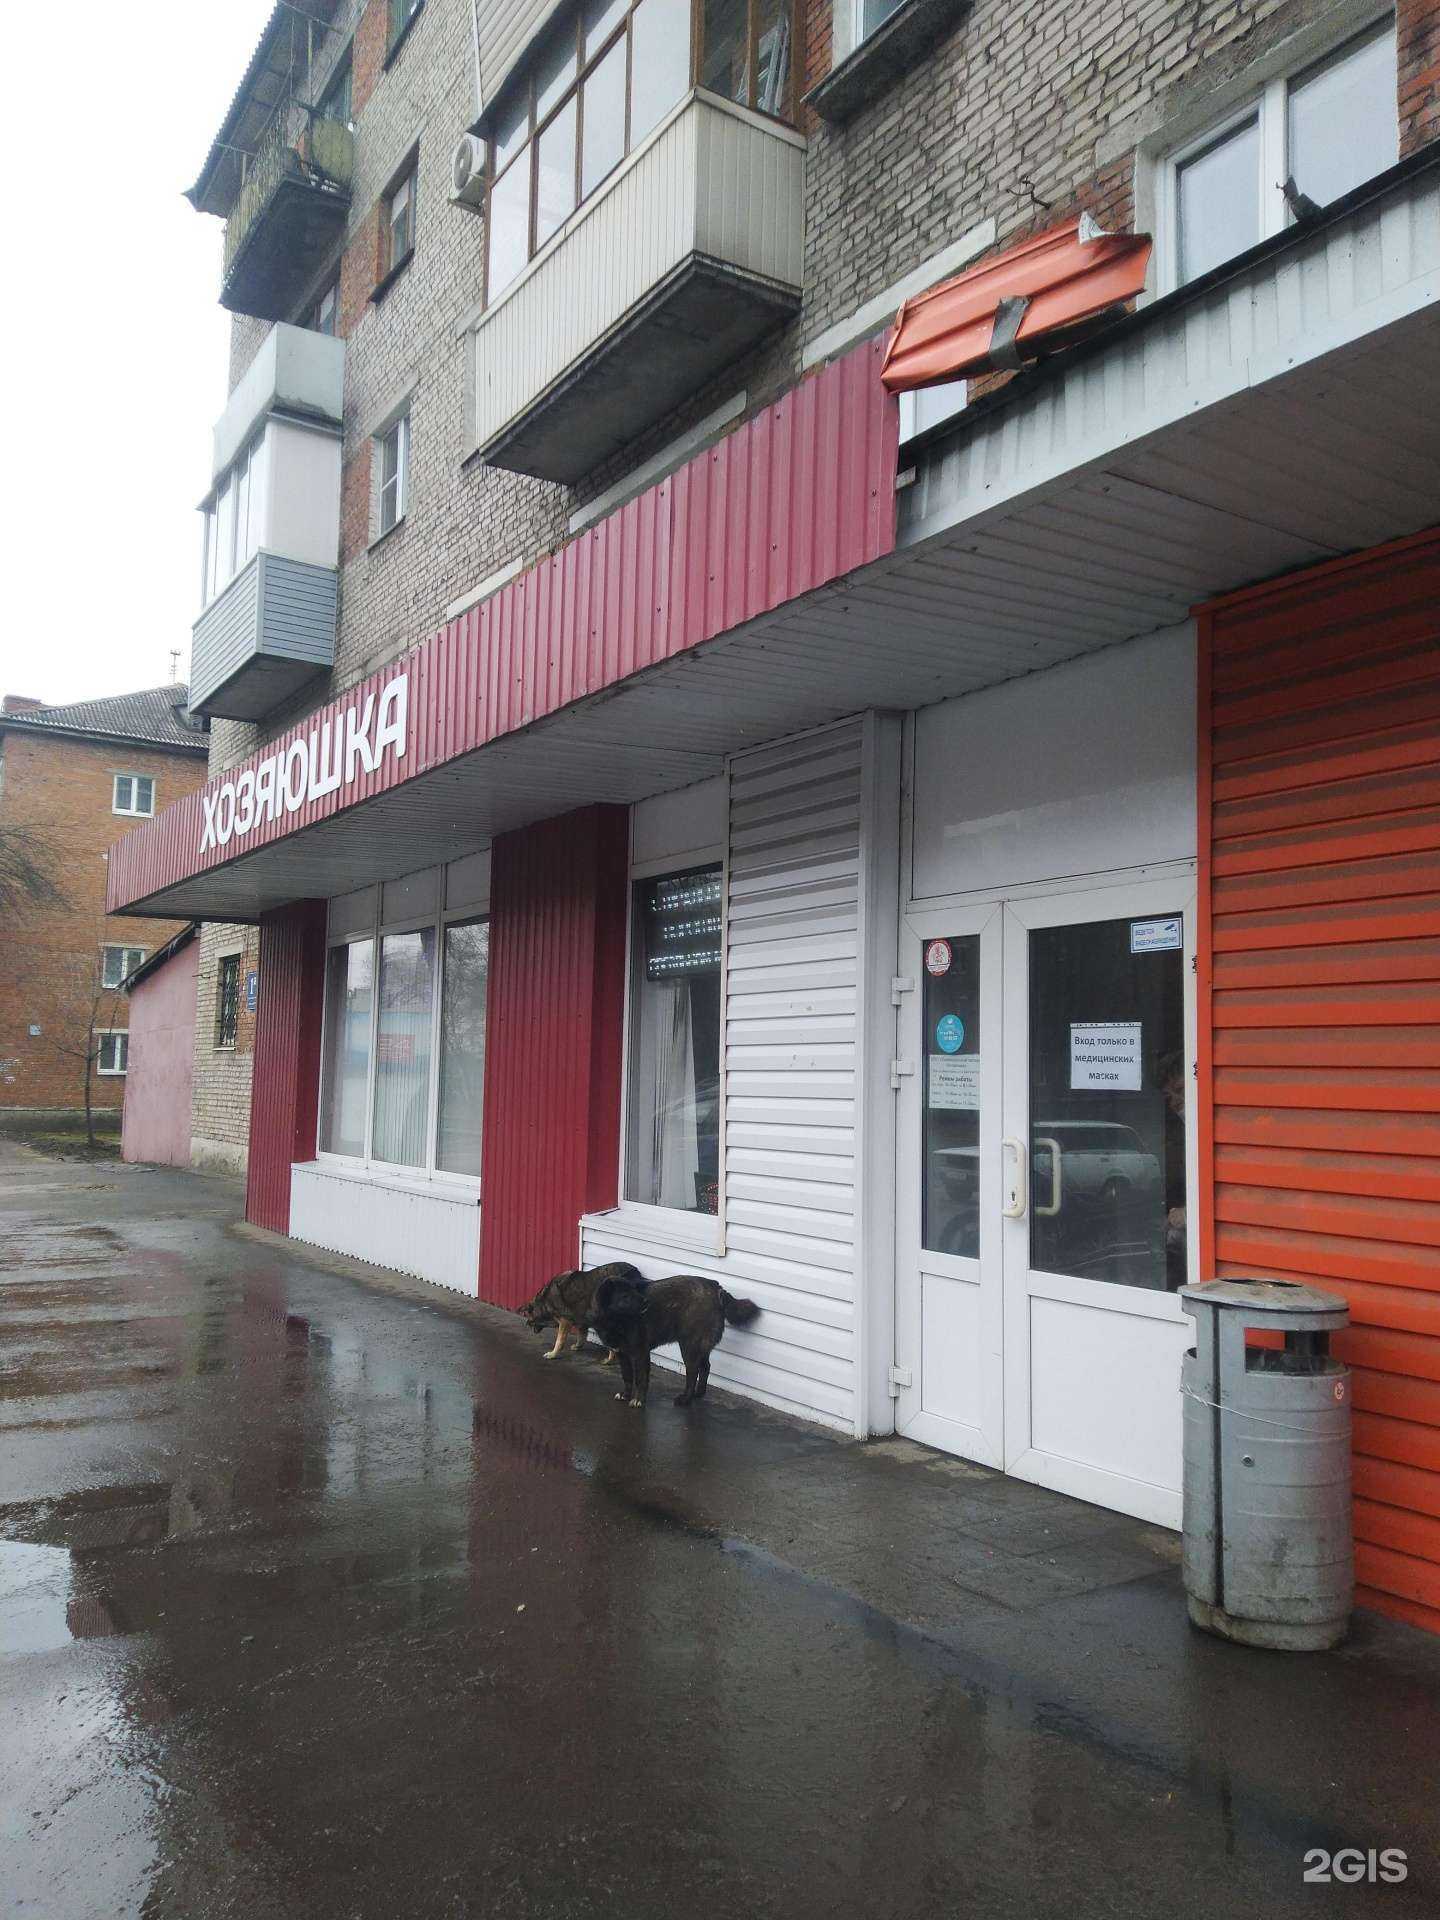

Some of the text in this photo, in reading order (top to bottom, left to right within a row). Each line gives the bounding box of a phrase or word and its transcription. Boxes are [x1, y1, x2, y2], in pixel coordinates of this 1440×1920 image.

[199, 673, 408, 854] ХОЗЯЮШКА
[1074, 1036, 1135, 1047] Вход только в
[1074, 1055, 1134, 1064] медицинских
[1088, 1072, 1119, 1081] масках
